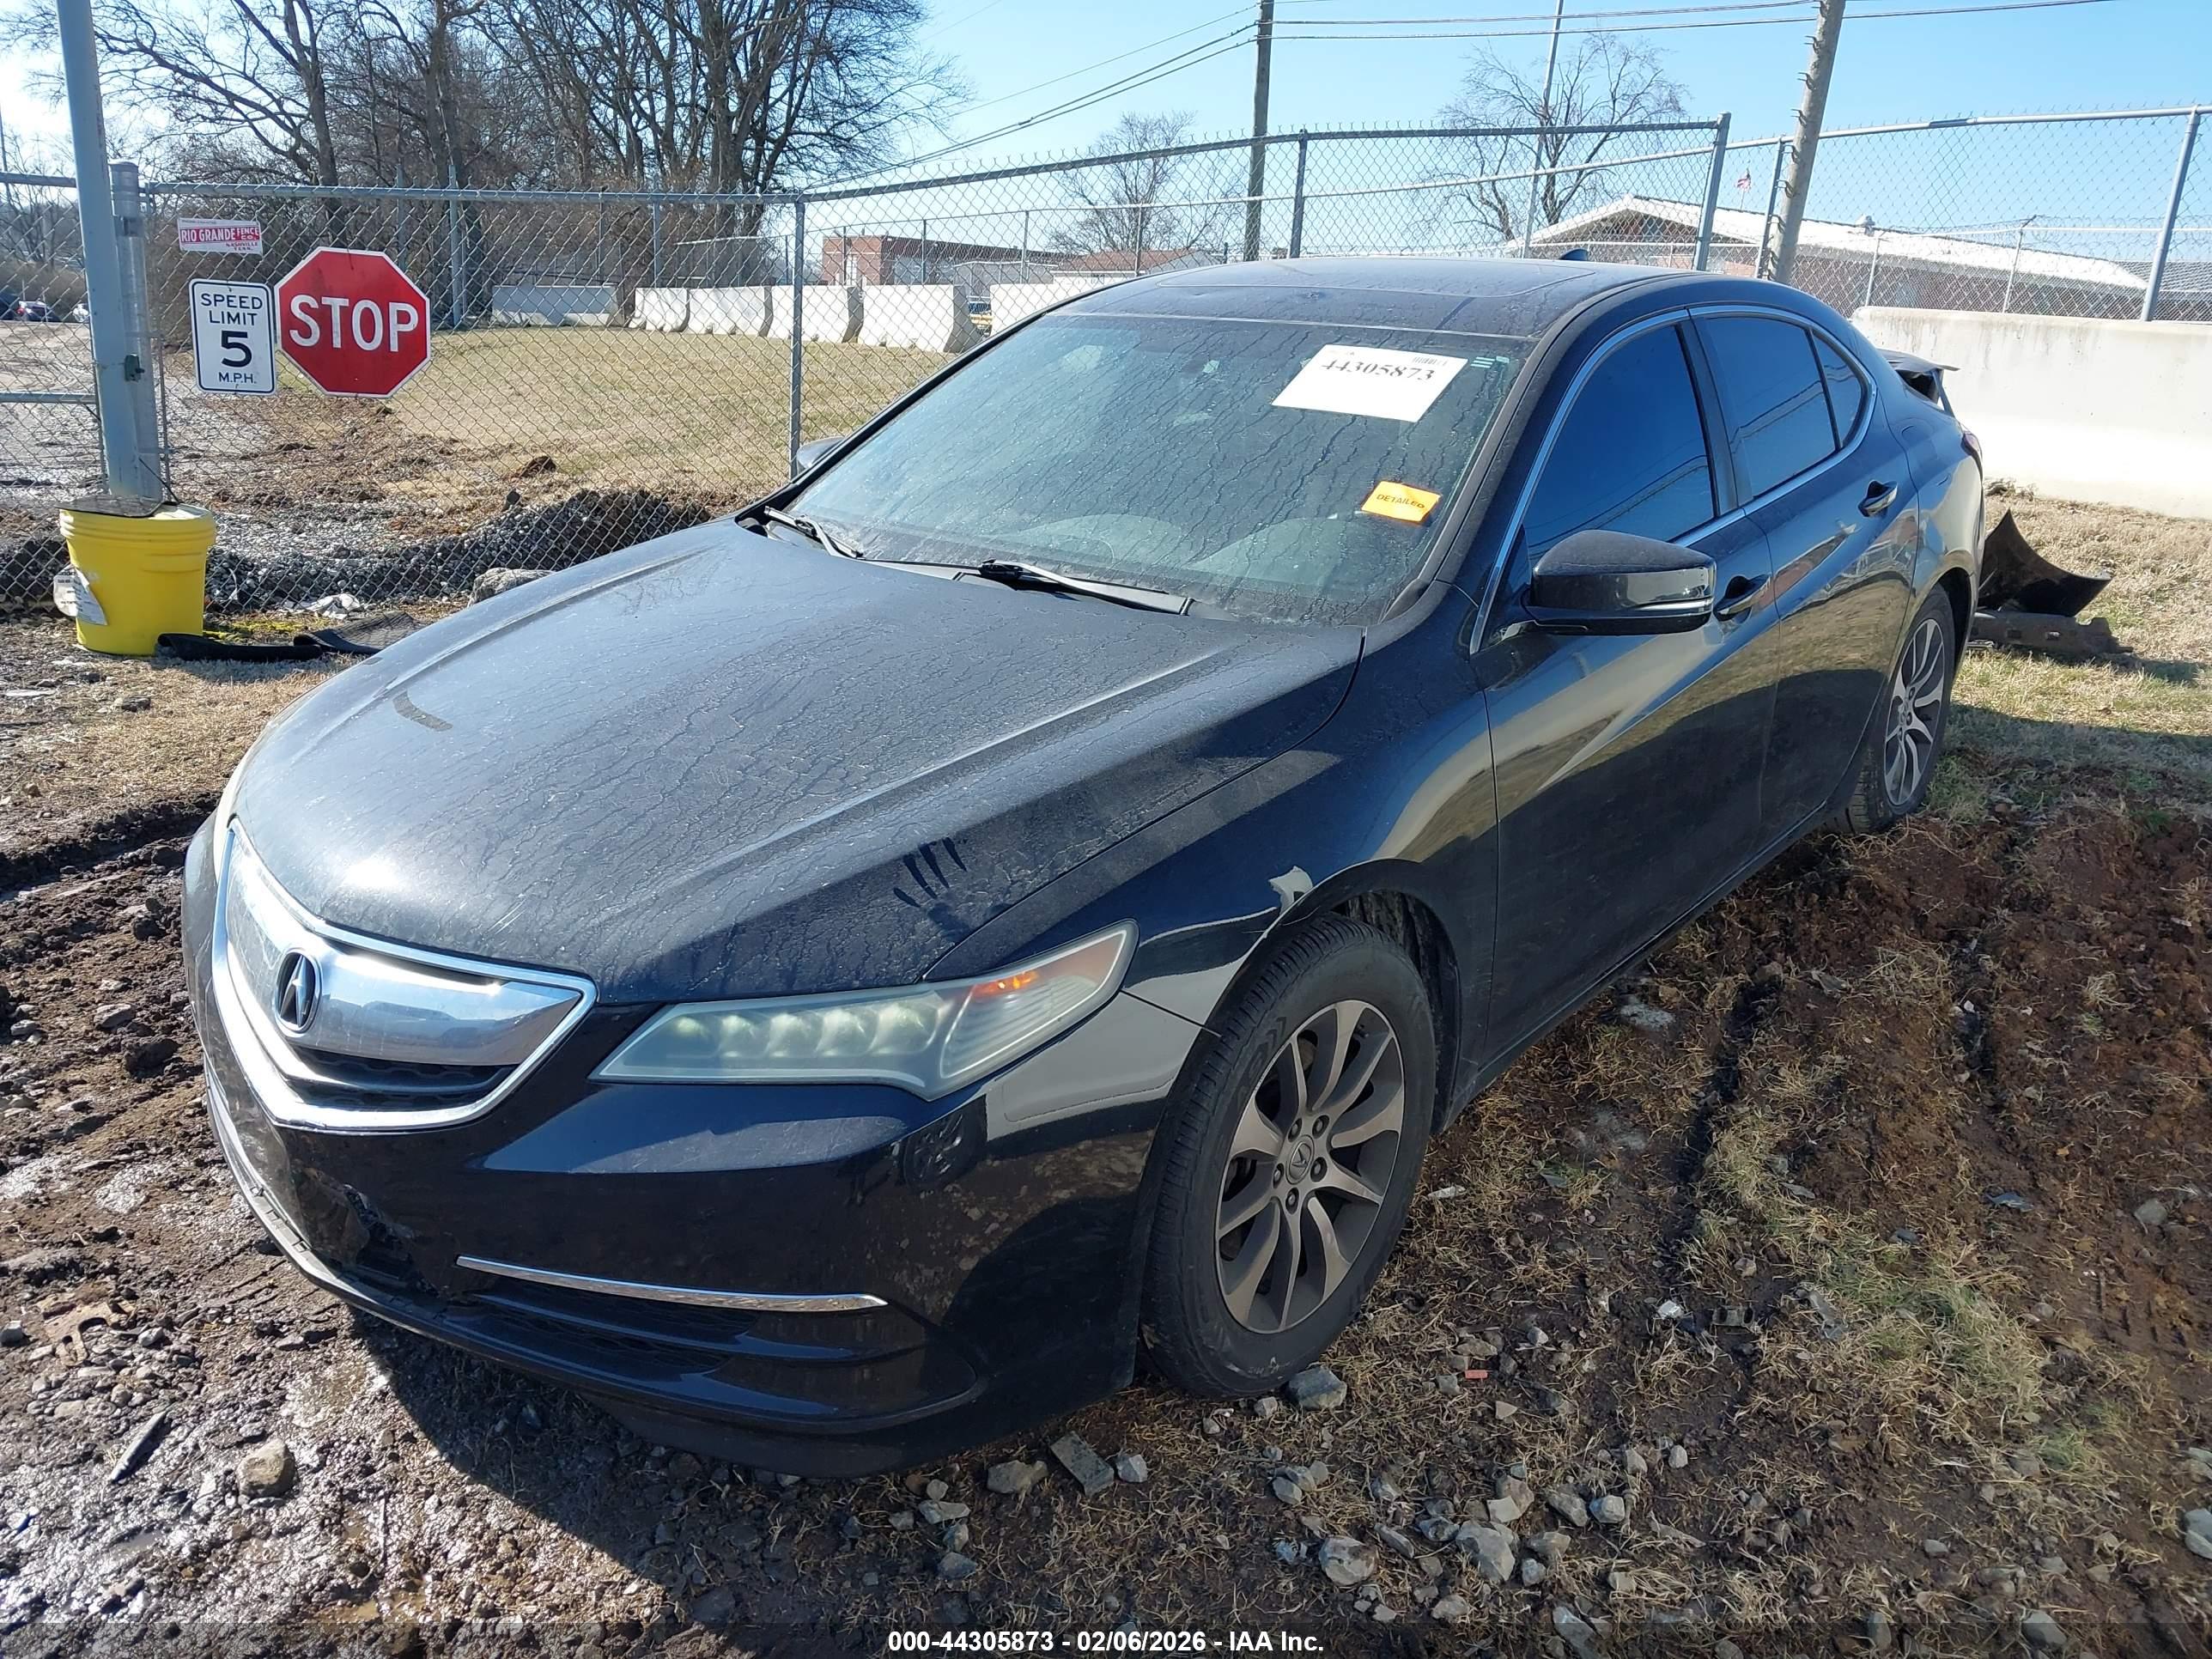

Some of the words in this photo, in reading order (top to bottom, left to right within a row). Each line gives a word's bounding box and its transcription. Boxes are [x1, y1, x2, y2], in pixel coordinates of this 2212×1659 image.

[181, 228, 197, 241] RIO
[198, 228, 236, 241] GRANDE
[236, 227, 259, 235] FENCE
[200, 293, 263, 310] SPEED
[209, 310, 258, 325] LIMIT
[289, 294, 419, 353] STOP
[221, 330, 252, 368] 5
[1321, 359, 1435, 380] 44305873
[218, 372, 257, 384] M.P.H.
[1376, 493, 1425, 509] DETAILED
